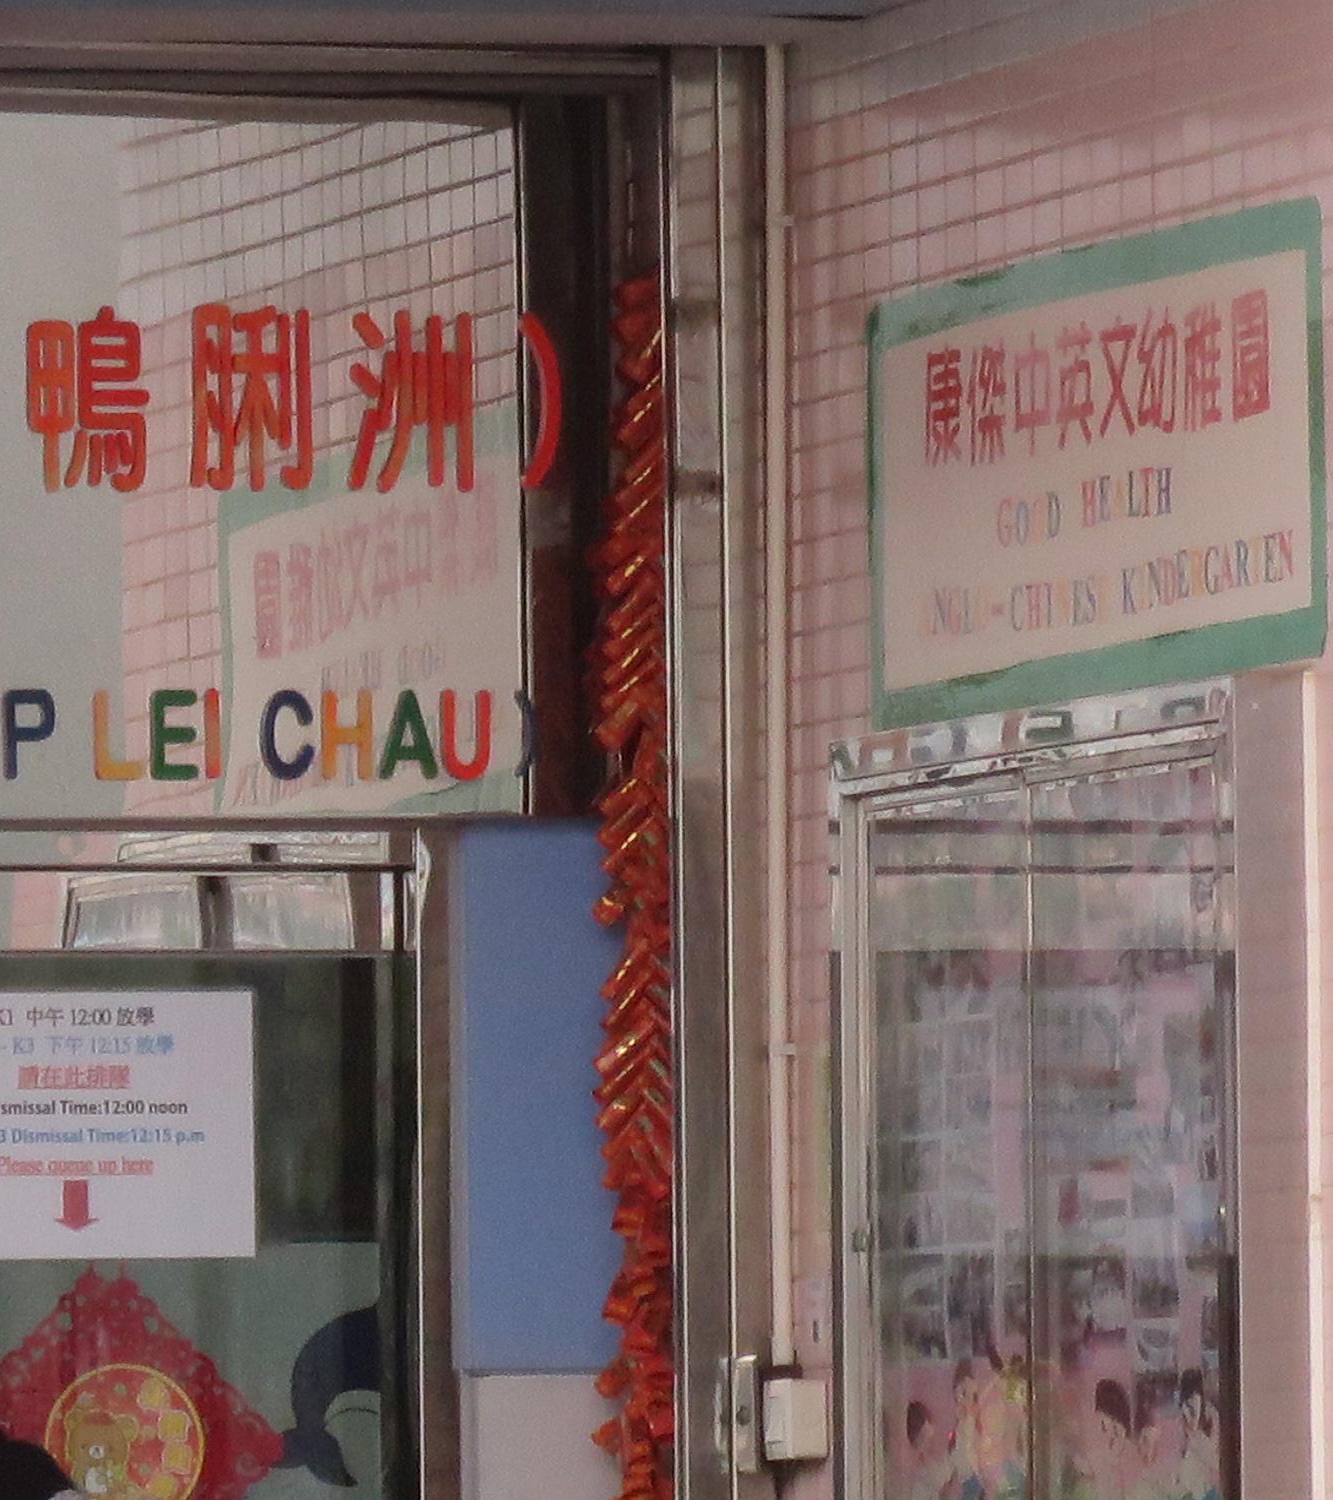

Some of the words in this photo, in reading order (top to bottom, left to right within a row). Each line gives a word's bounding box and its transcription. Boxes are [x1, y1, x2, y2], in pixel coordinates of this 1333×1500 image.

[93, 687, 221, 782] LEI
[26, 1007, 65, 1027] 中午
[70, 1008, 112, 1026] 12:00
[148, 1102, 189, 1115] noon
[12, 1127, 83, 1144] Dismissal
